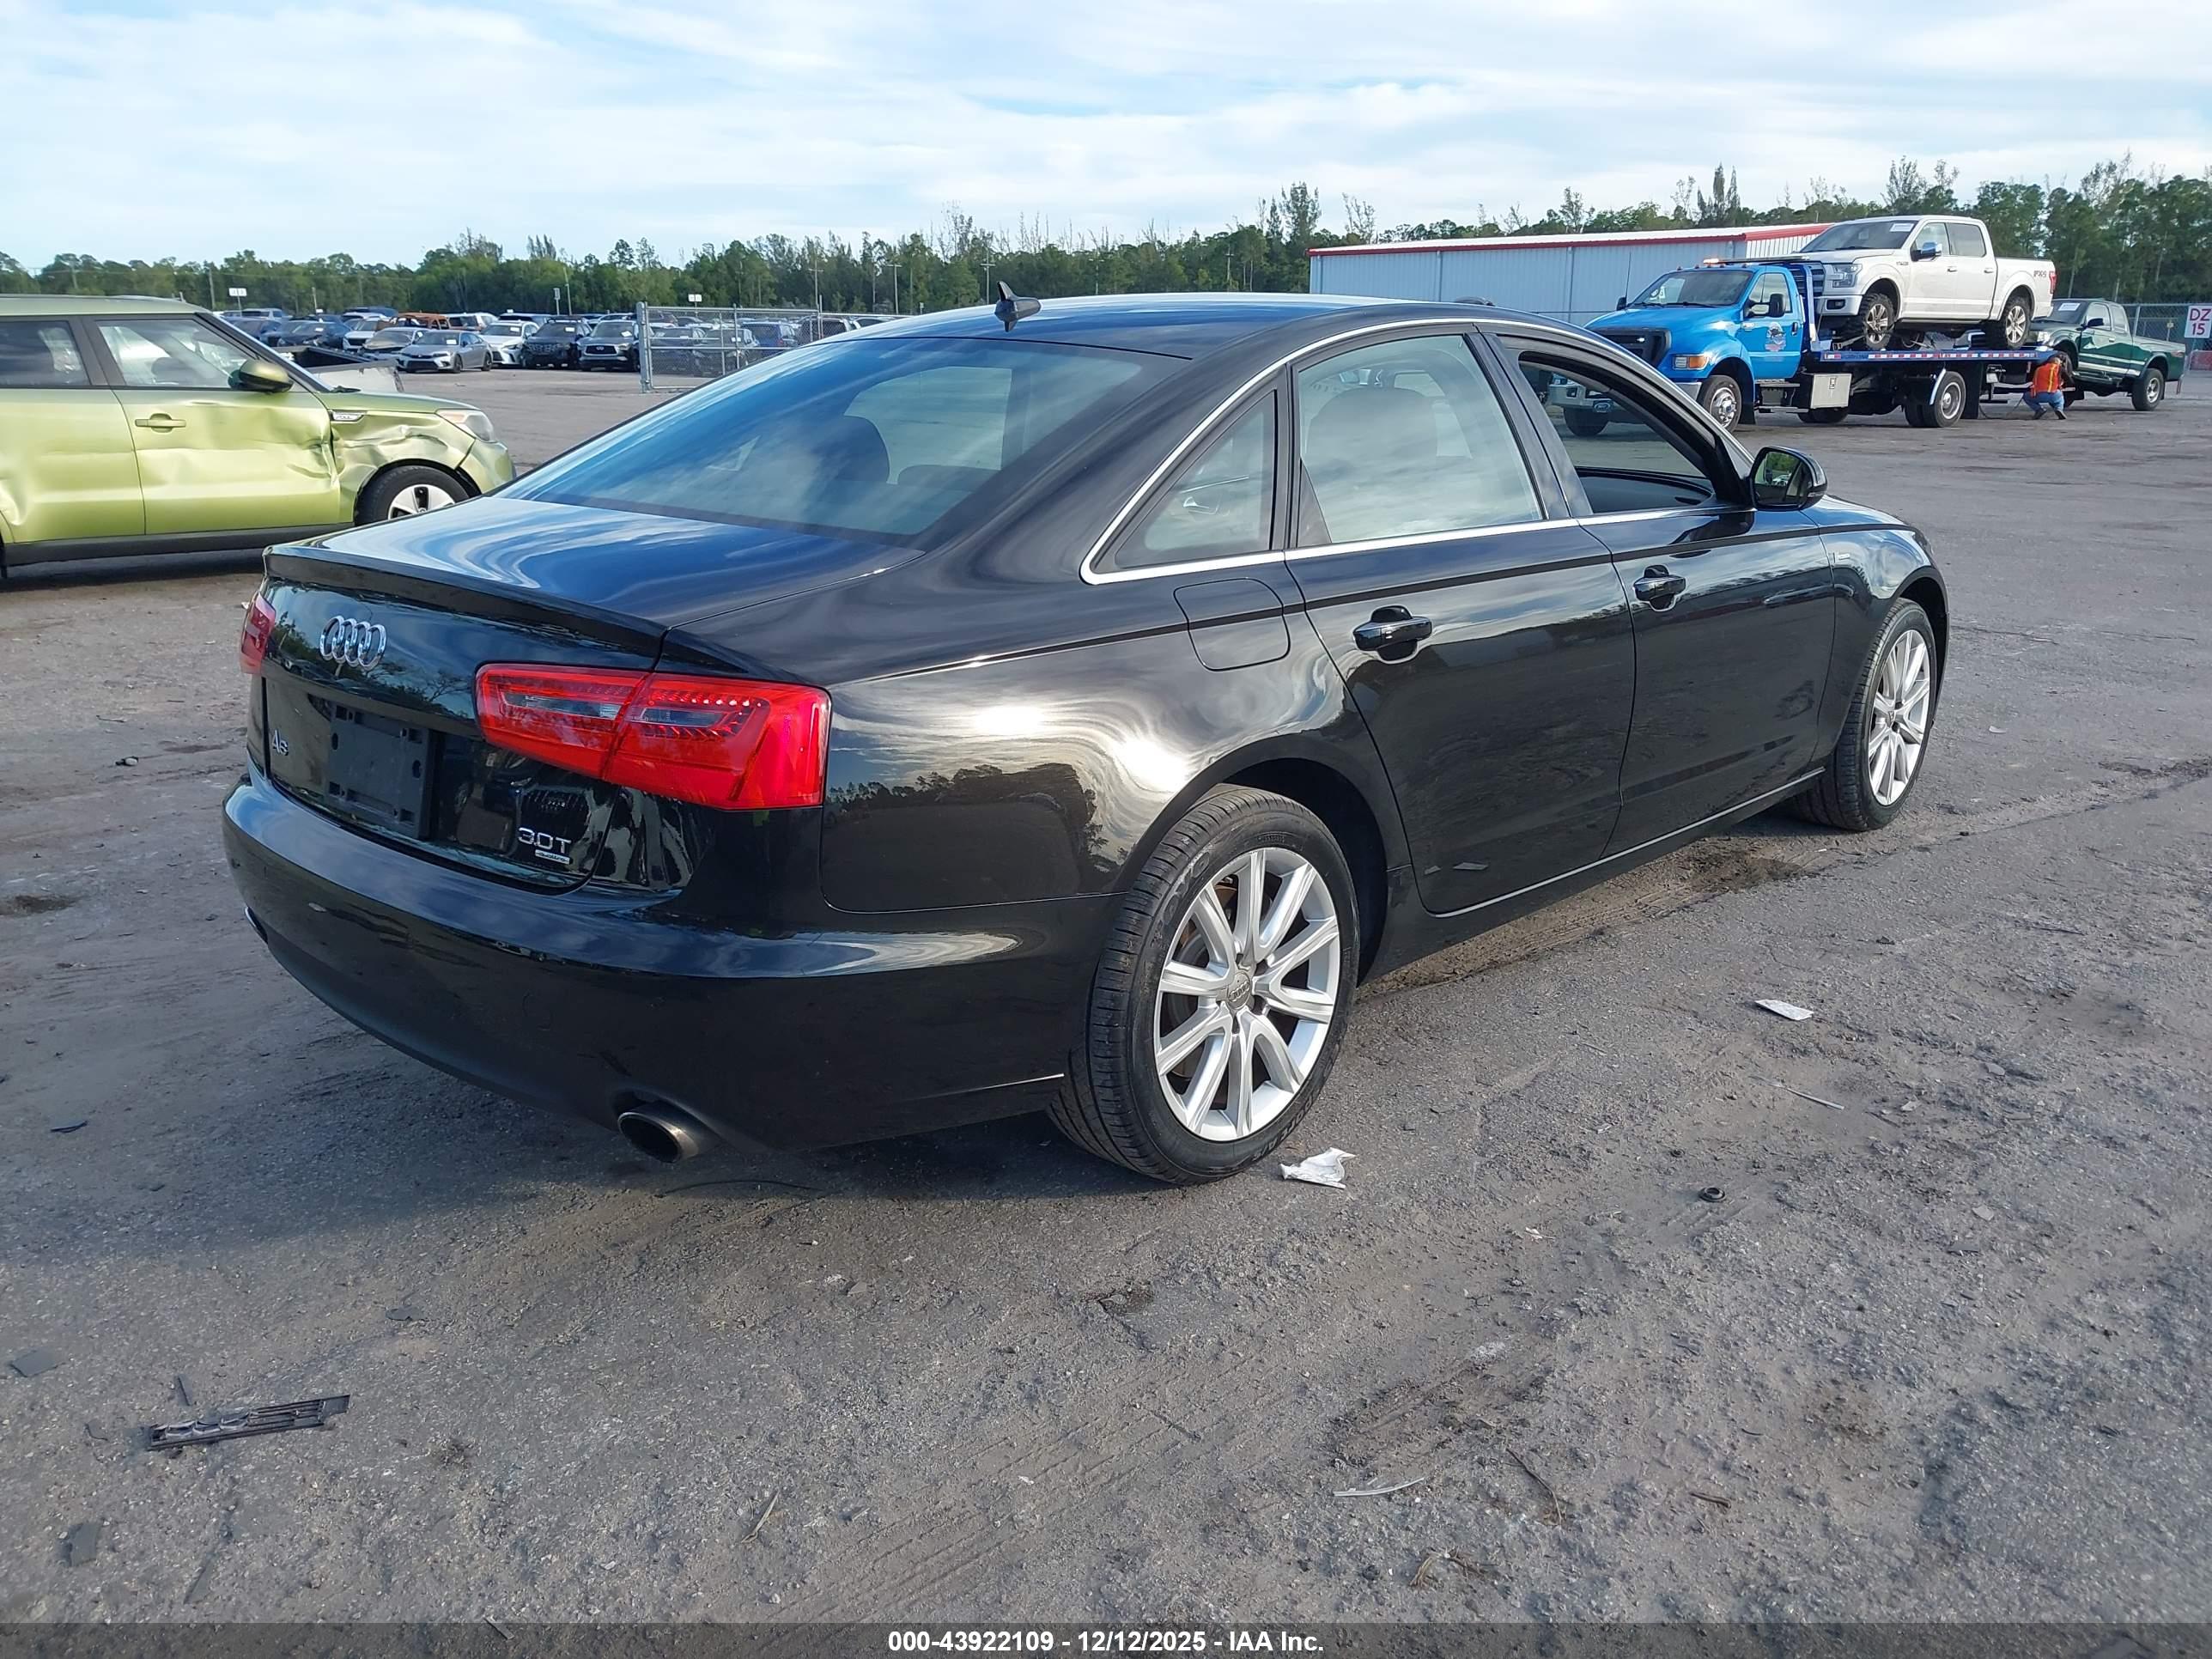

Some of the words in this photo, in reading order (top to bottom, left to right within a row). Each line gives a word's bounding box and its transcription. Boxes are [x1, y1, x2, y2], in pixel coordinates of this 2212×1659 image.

[2190, 307, 2211, 321] DZ
[2192, 323, 2205, 335] 15
[271, 729, 289, 755] A6
